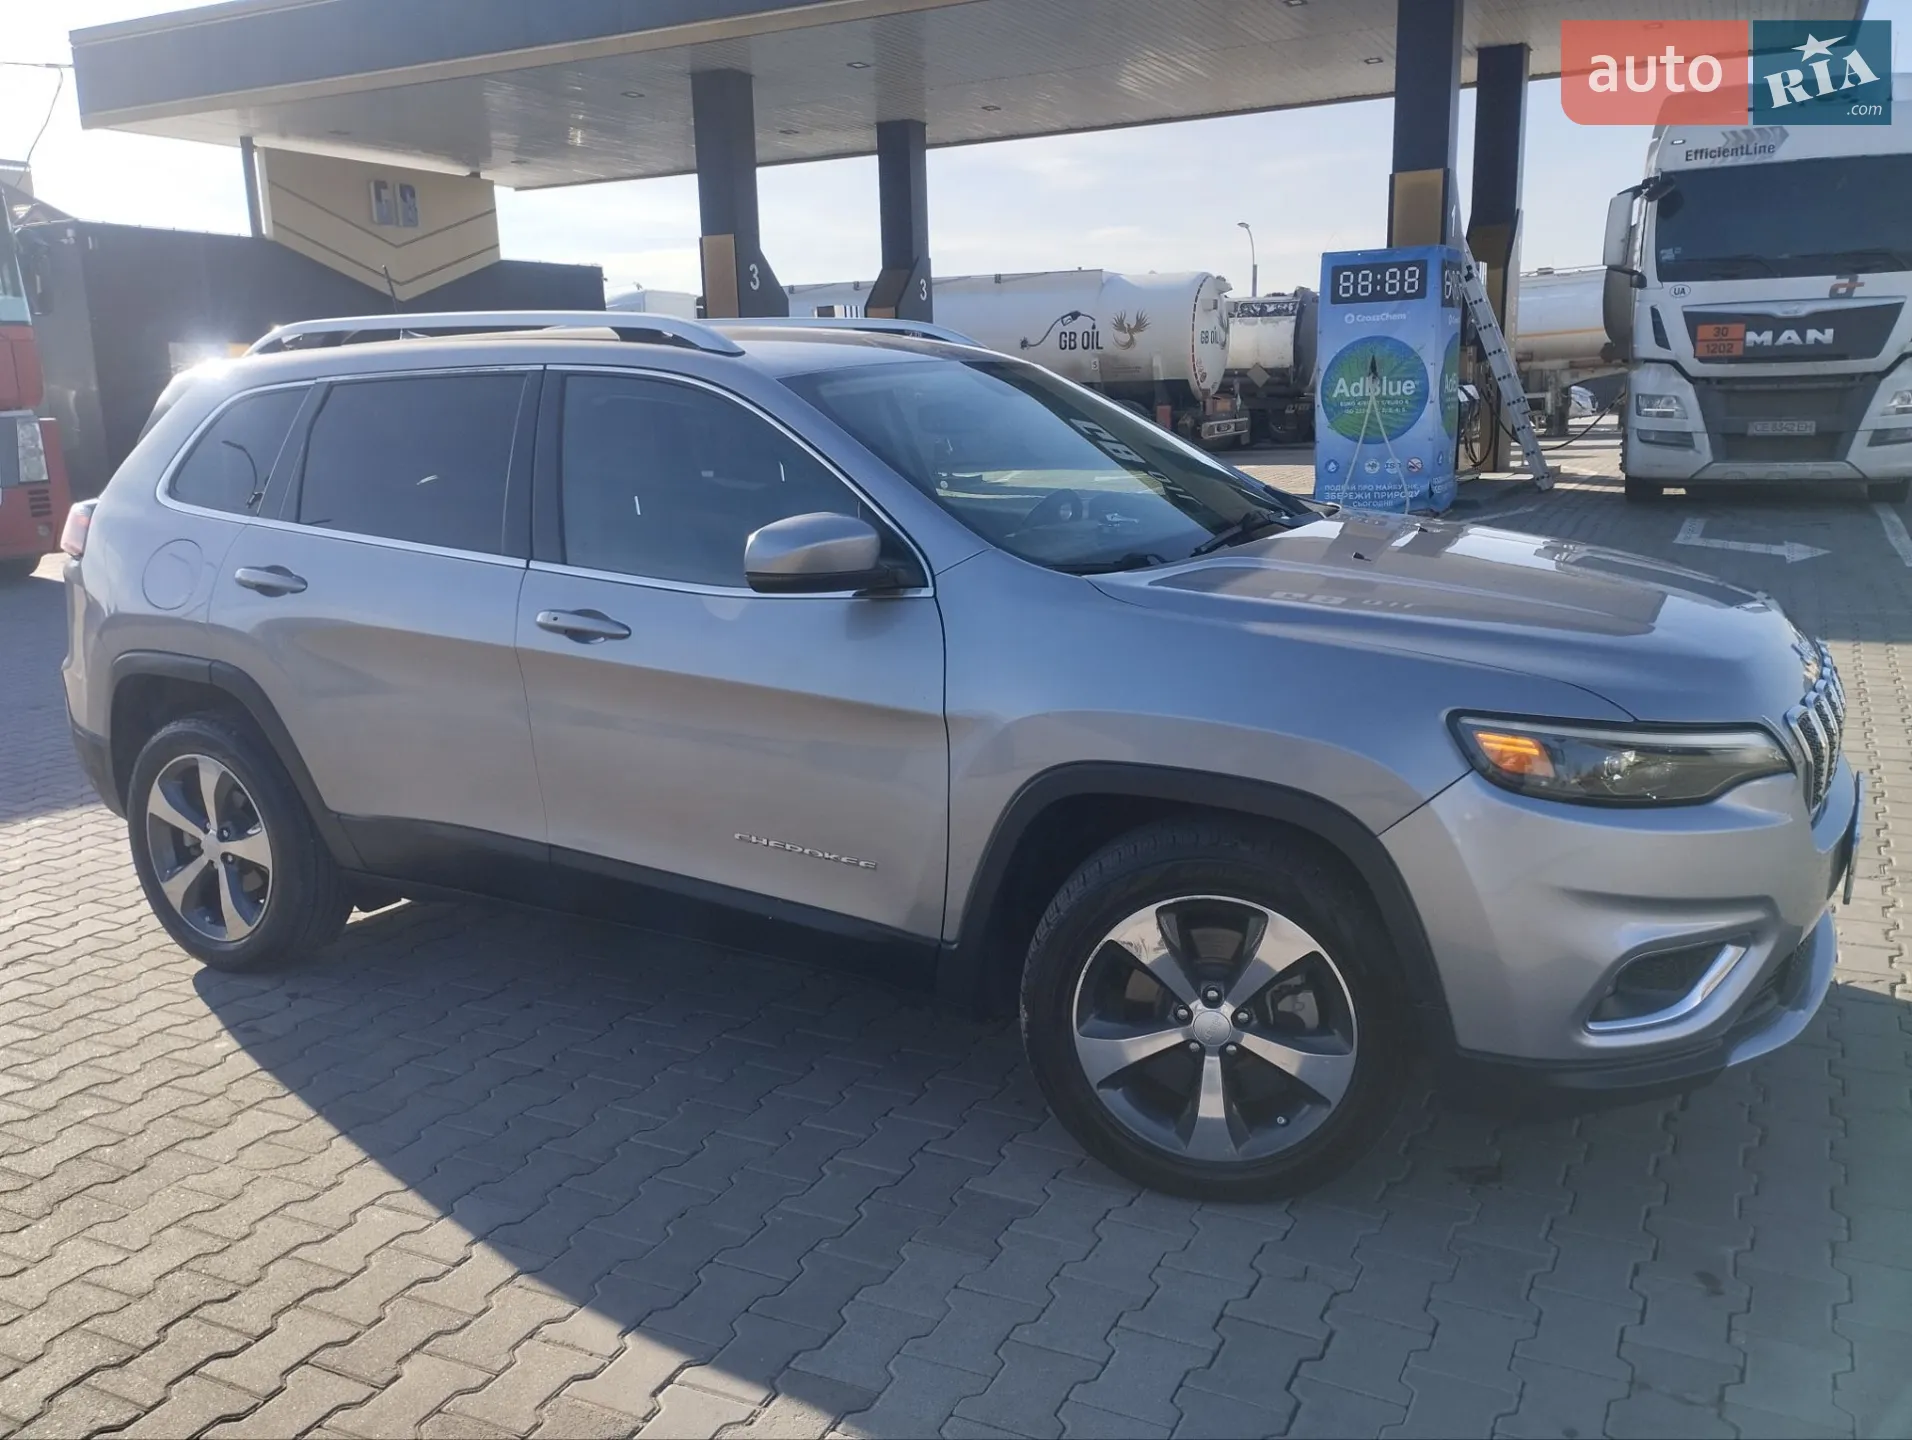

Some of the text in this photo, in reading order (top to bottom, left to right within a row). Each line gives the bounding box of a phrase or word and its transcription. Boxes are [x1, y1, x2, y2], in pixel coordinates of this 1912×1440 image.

[1684, 141, 1776, 162] EfficientLine
[749, 263, 761, 291] 3
[1338, 266, 1420, 298] 88:88
[919, 278, 928, 301] 3
[1673, 287, 1686, 296] UA
[1059, 330, 1104, 351] GB OIL
[1200, 330, 1210, 345] GB
[1712, 326, 1729, 338] 30
[1745, 328, 1834, 347] MAN
[1705, 342, 1735, 354] 1202
